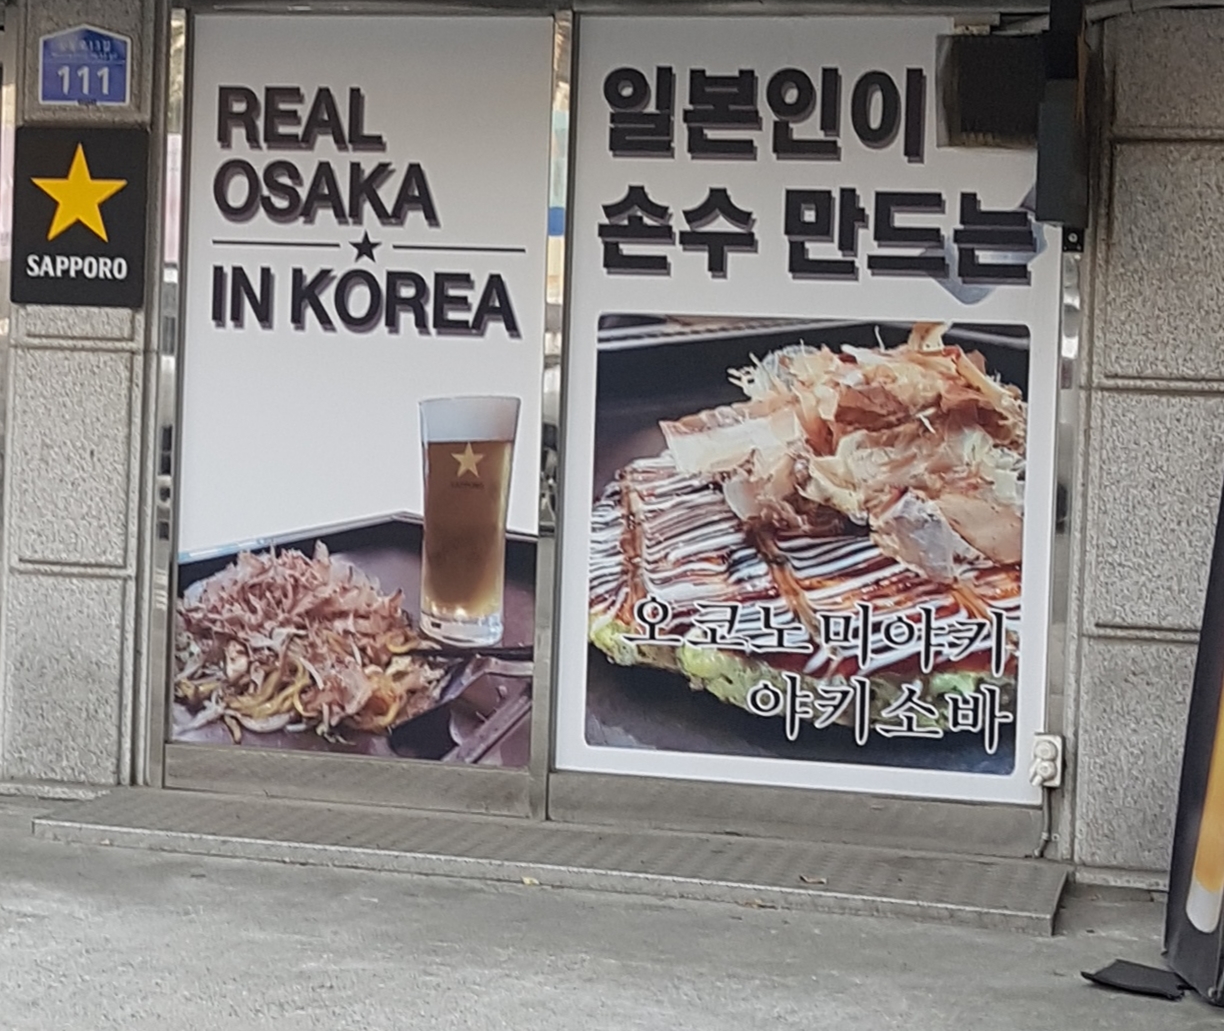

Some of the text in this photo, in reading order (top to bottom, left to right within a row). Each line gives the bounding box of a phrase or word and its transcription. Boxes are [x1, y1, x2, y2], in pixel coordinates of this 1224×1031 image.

[57, 65, 109, 96] 111
[602, 65, 927, 164] 일본인이
[217, 86, 387, 151] REAL
[213, 159, 441, 228] OSAKA
[26, 254, 128, 280] SAPPORO
[598, 185, 1038, 286] 손수 만드는
[211, 265, 522, 340] IN KOREA
[622, 595, 1007, 677] 오코노미야키
[746, 673, 1014, 755] 야키소바
